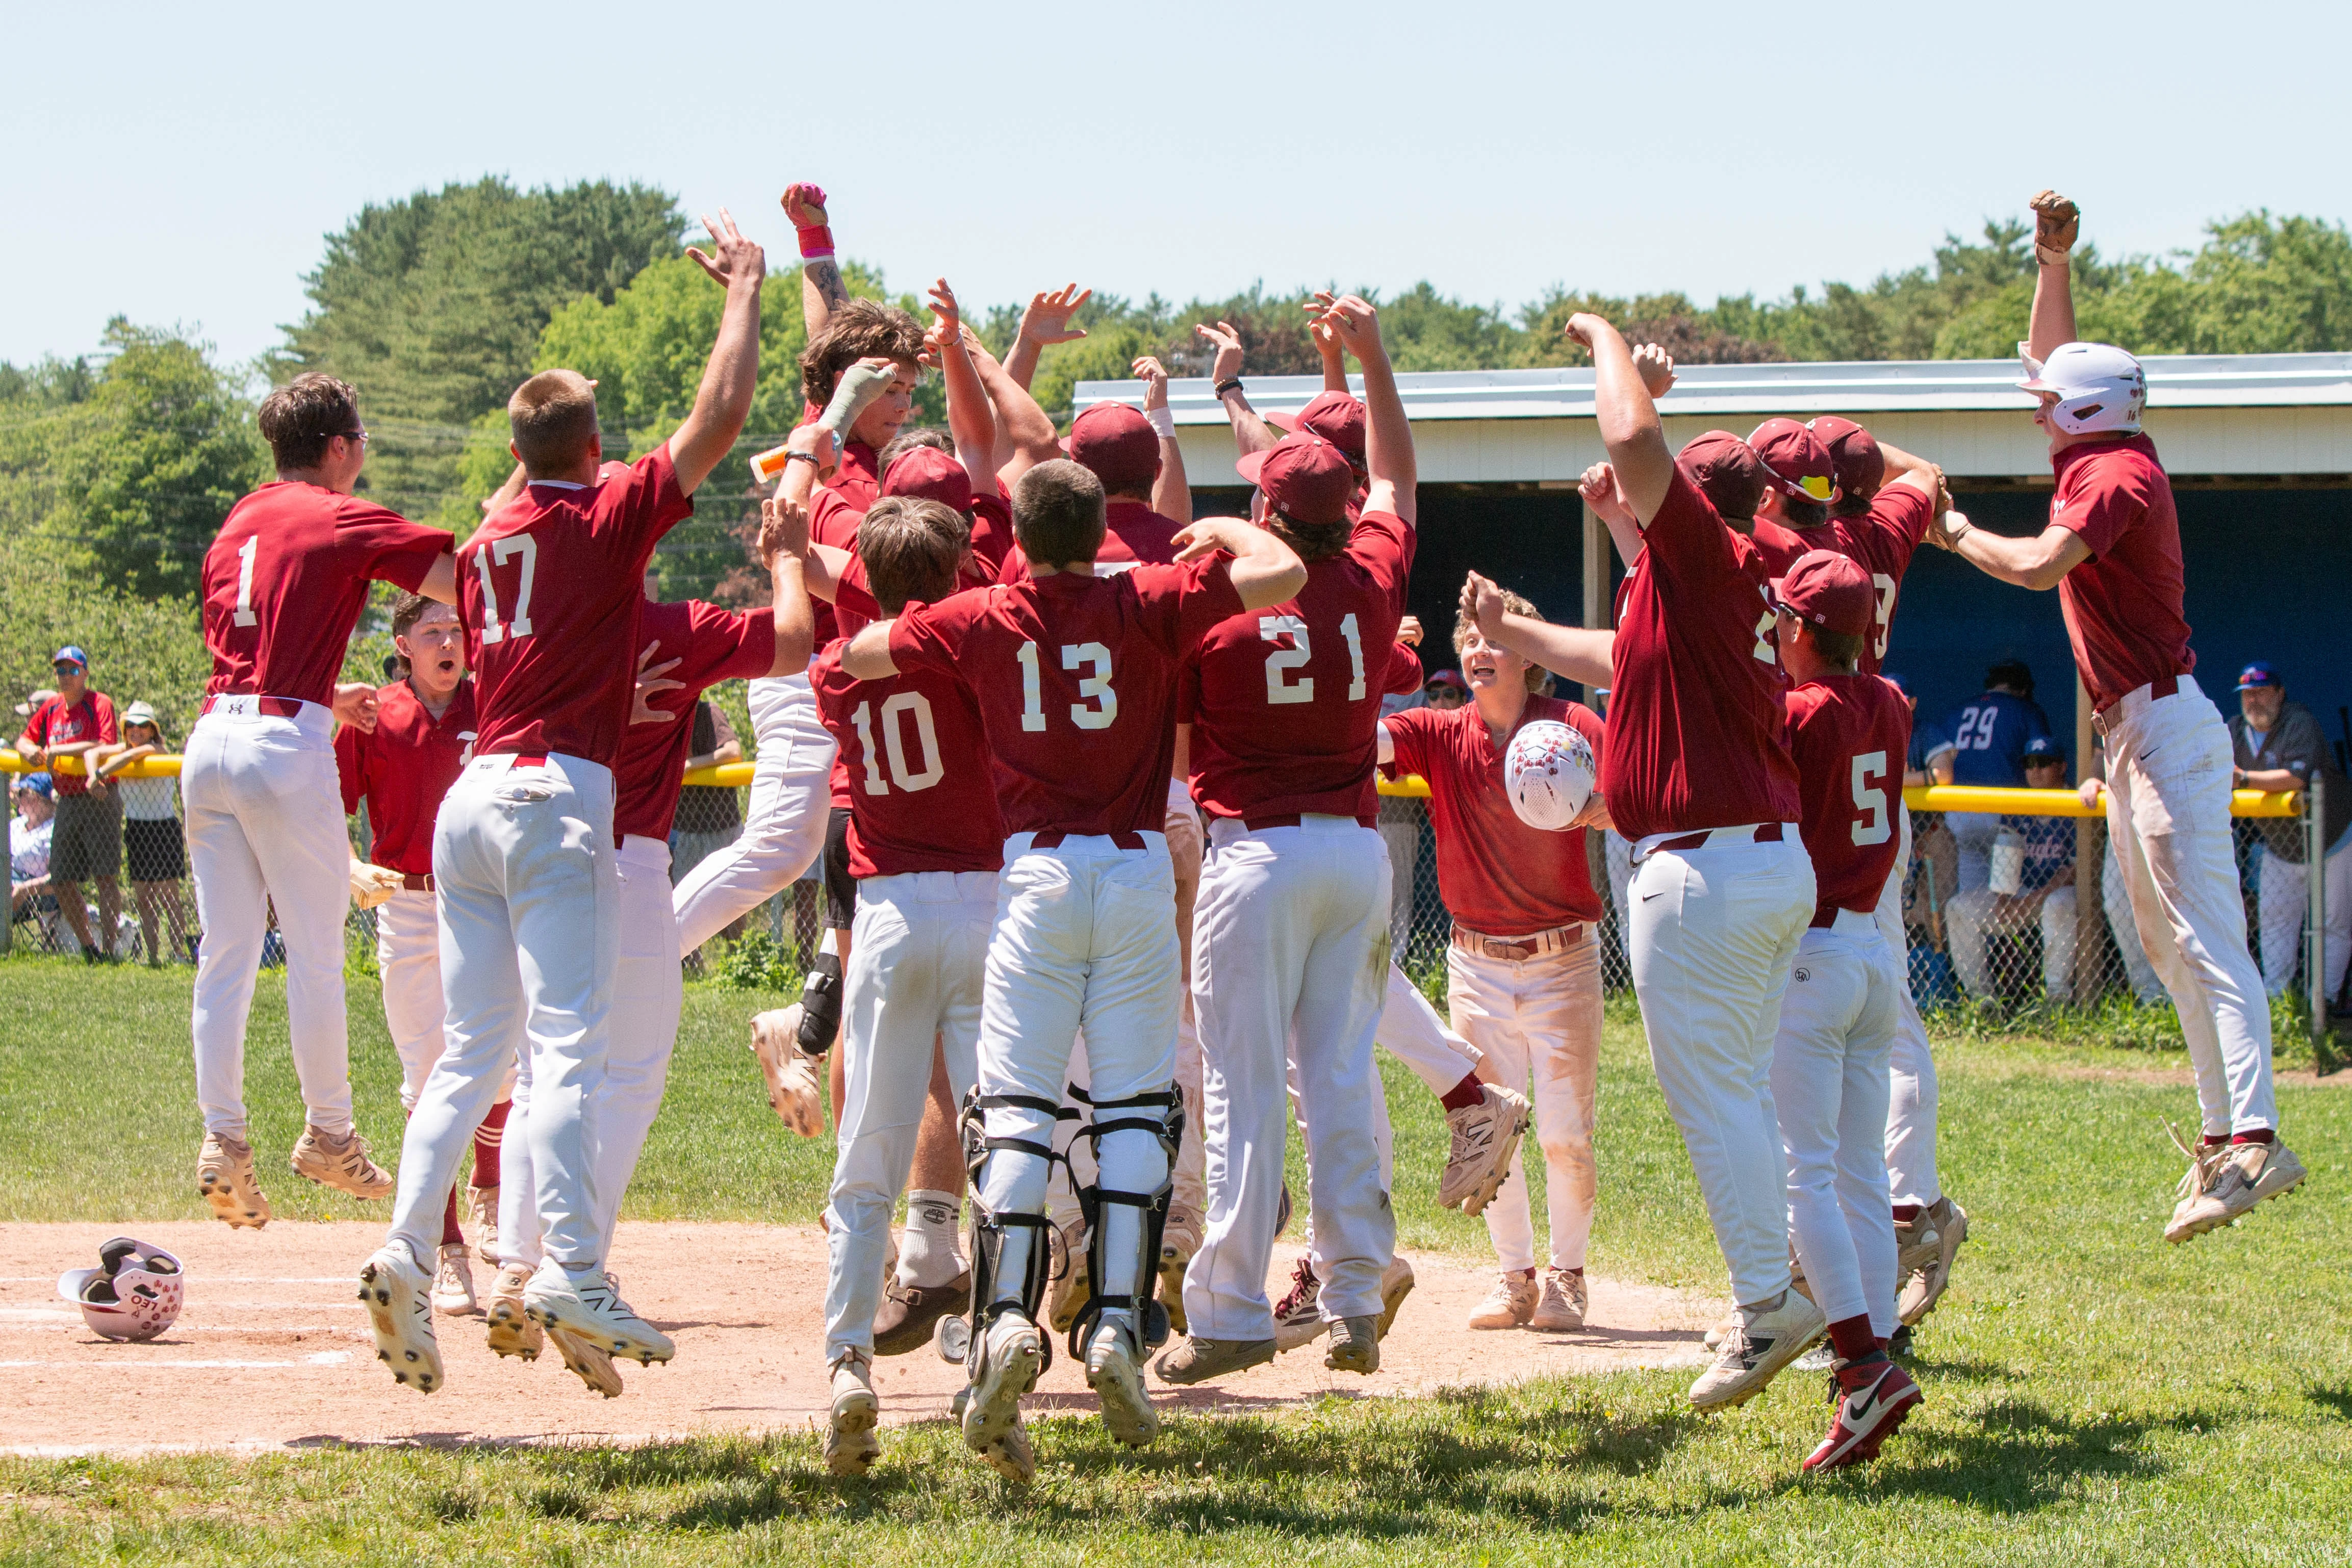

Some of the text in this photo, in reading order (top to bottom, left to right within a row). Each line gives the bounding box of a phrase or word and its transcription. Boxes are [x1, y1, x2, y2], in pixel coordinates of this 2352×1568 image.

[2127, 409, 2136, 421] 16
[233, 534, 260, 627] 1
[473, 532, 537, 645] 17
[1017, 640, 1117, 732] 13
[1259, 613, 1366, 704] 21
[851, 691, 944, 795] 10
[1955, 706, 1999, 750] 29
[1851, 750, 1891, 846] 5
[131, 1295, 158, 1311] LEO
